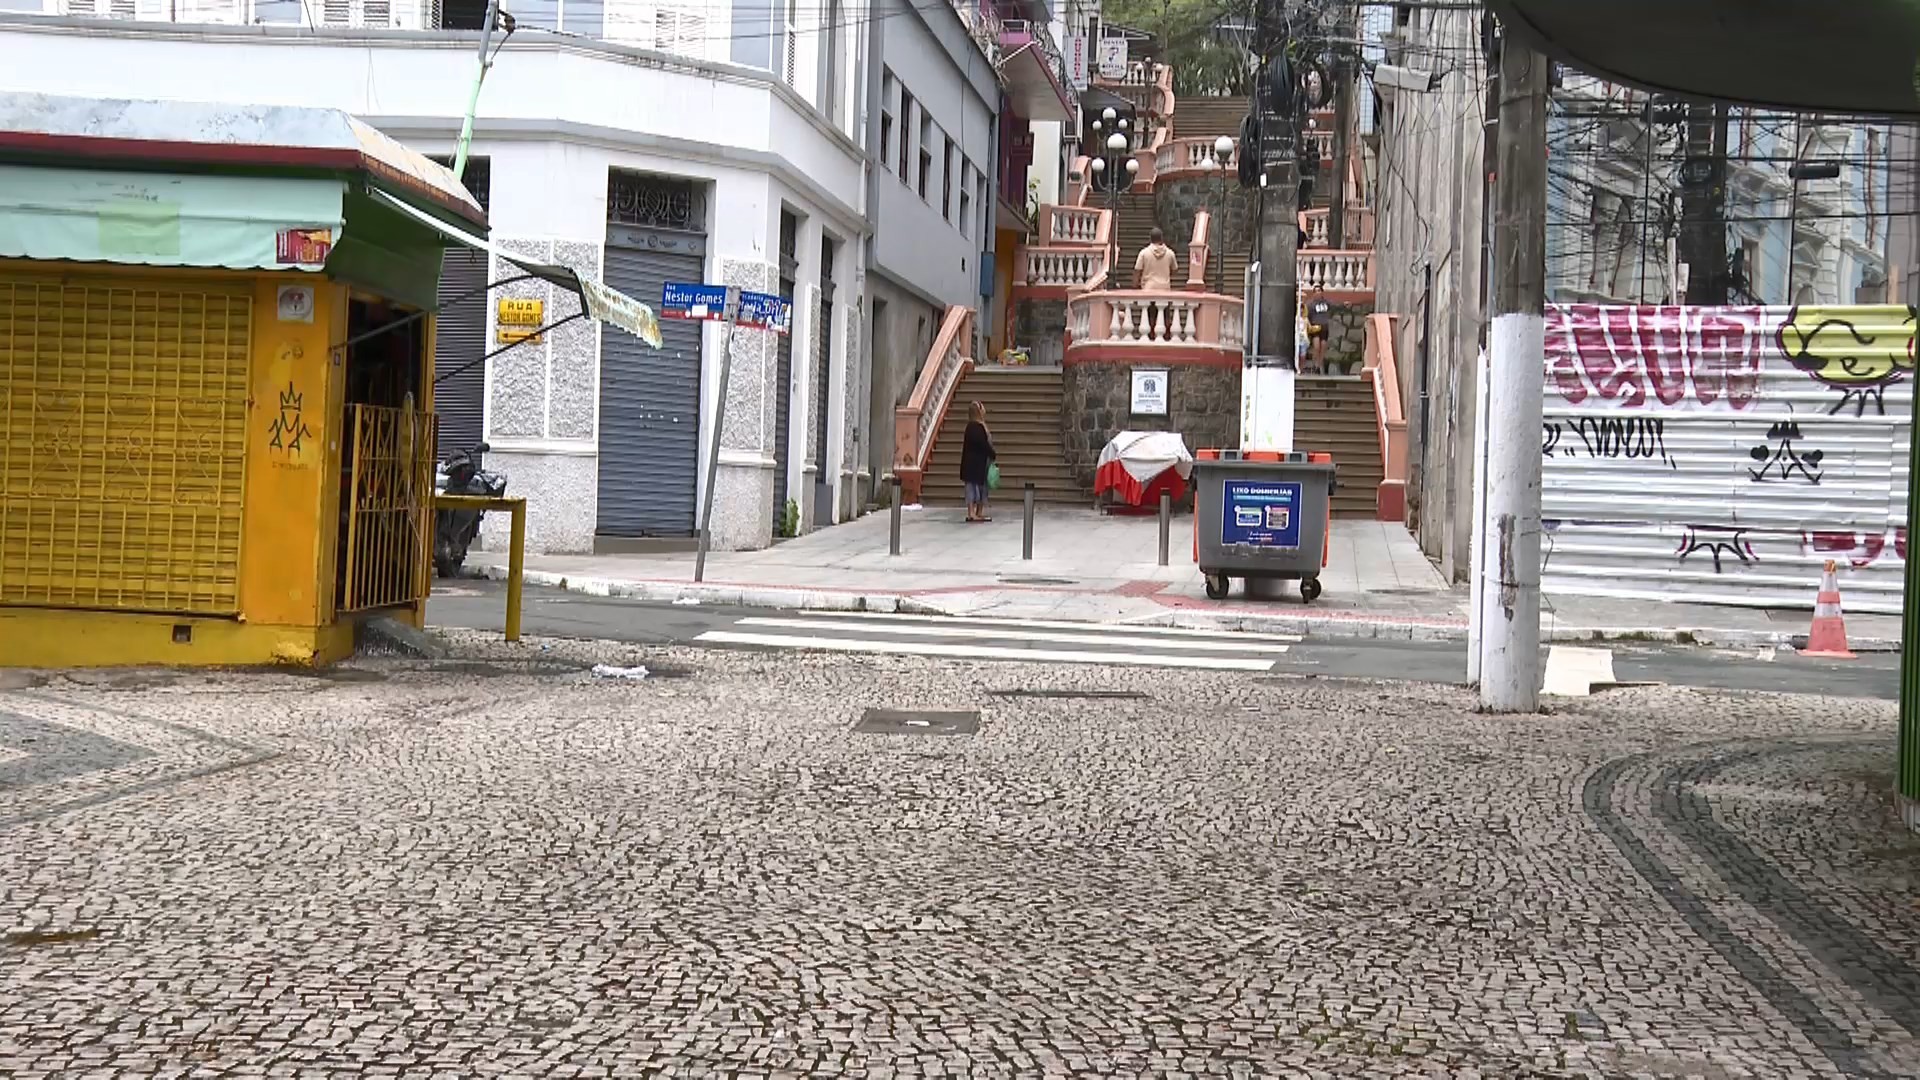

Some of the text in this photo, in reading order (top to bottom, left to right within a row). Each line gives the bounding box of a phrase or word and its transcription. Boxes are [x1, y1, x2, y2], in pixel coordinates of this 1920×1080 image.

[665, 291, 723, 304] Nestor Gomes
[507, 302, 533, 310] RUA
[1232, 487, 1250, 495] LIXO
